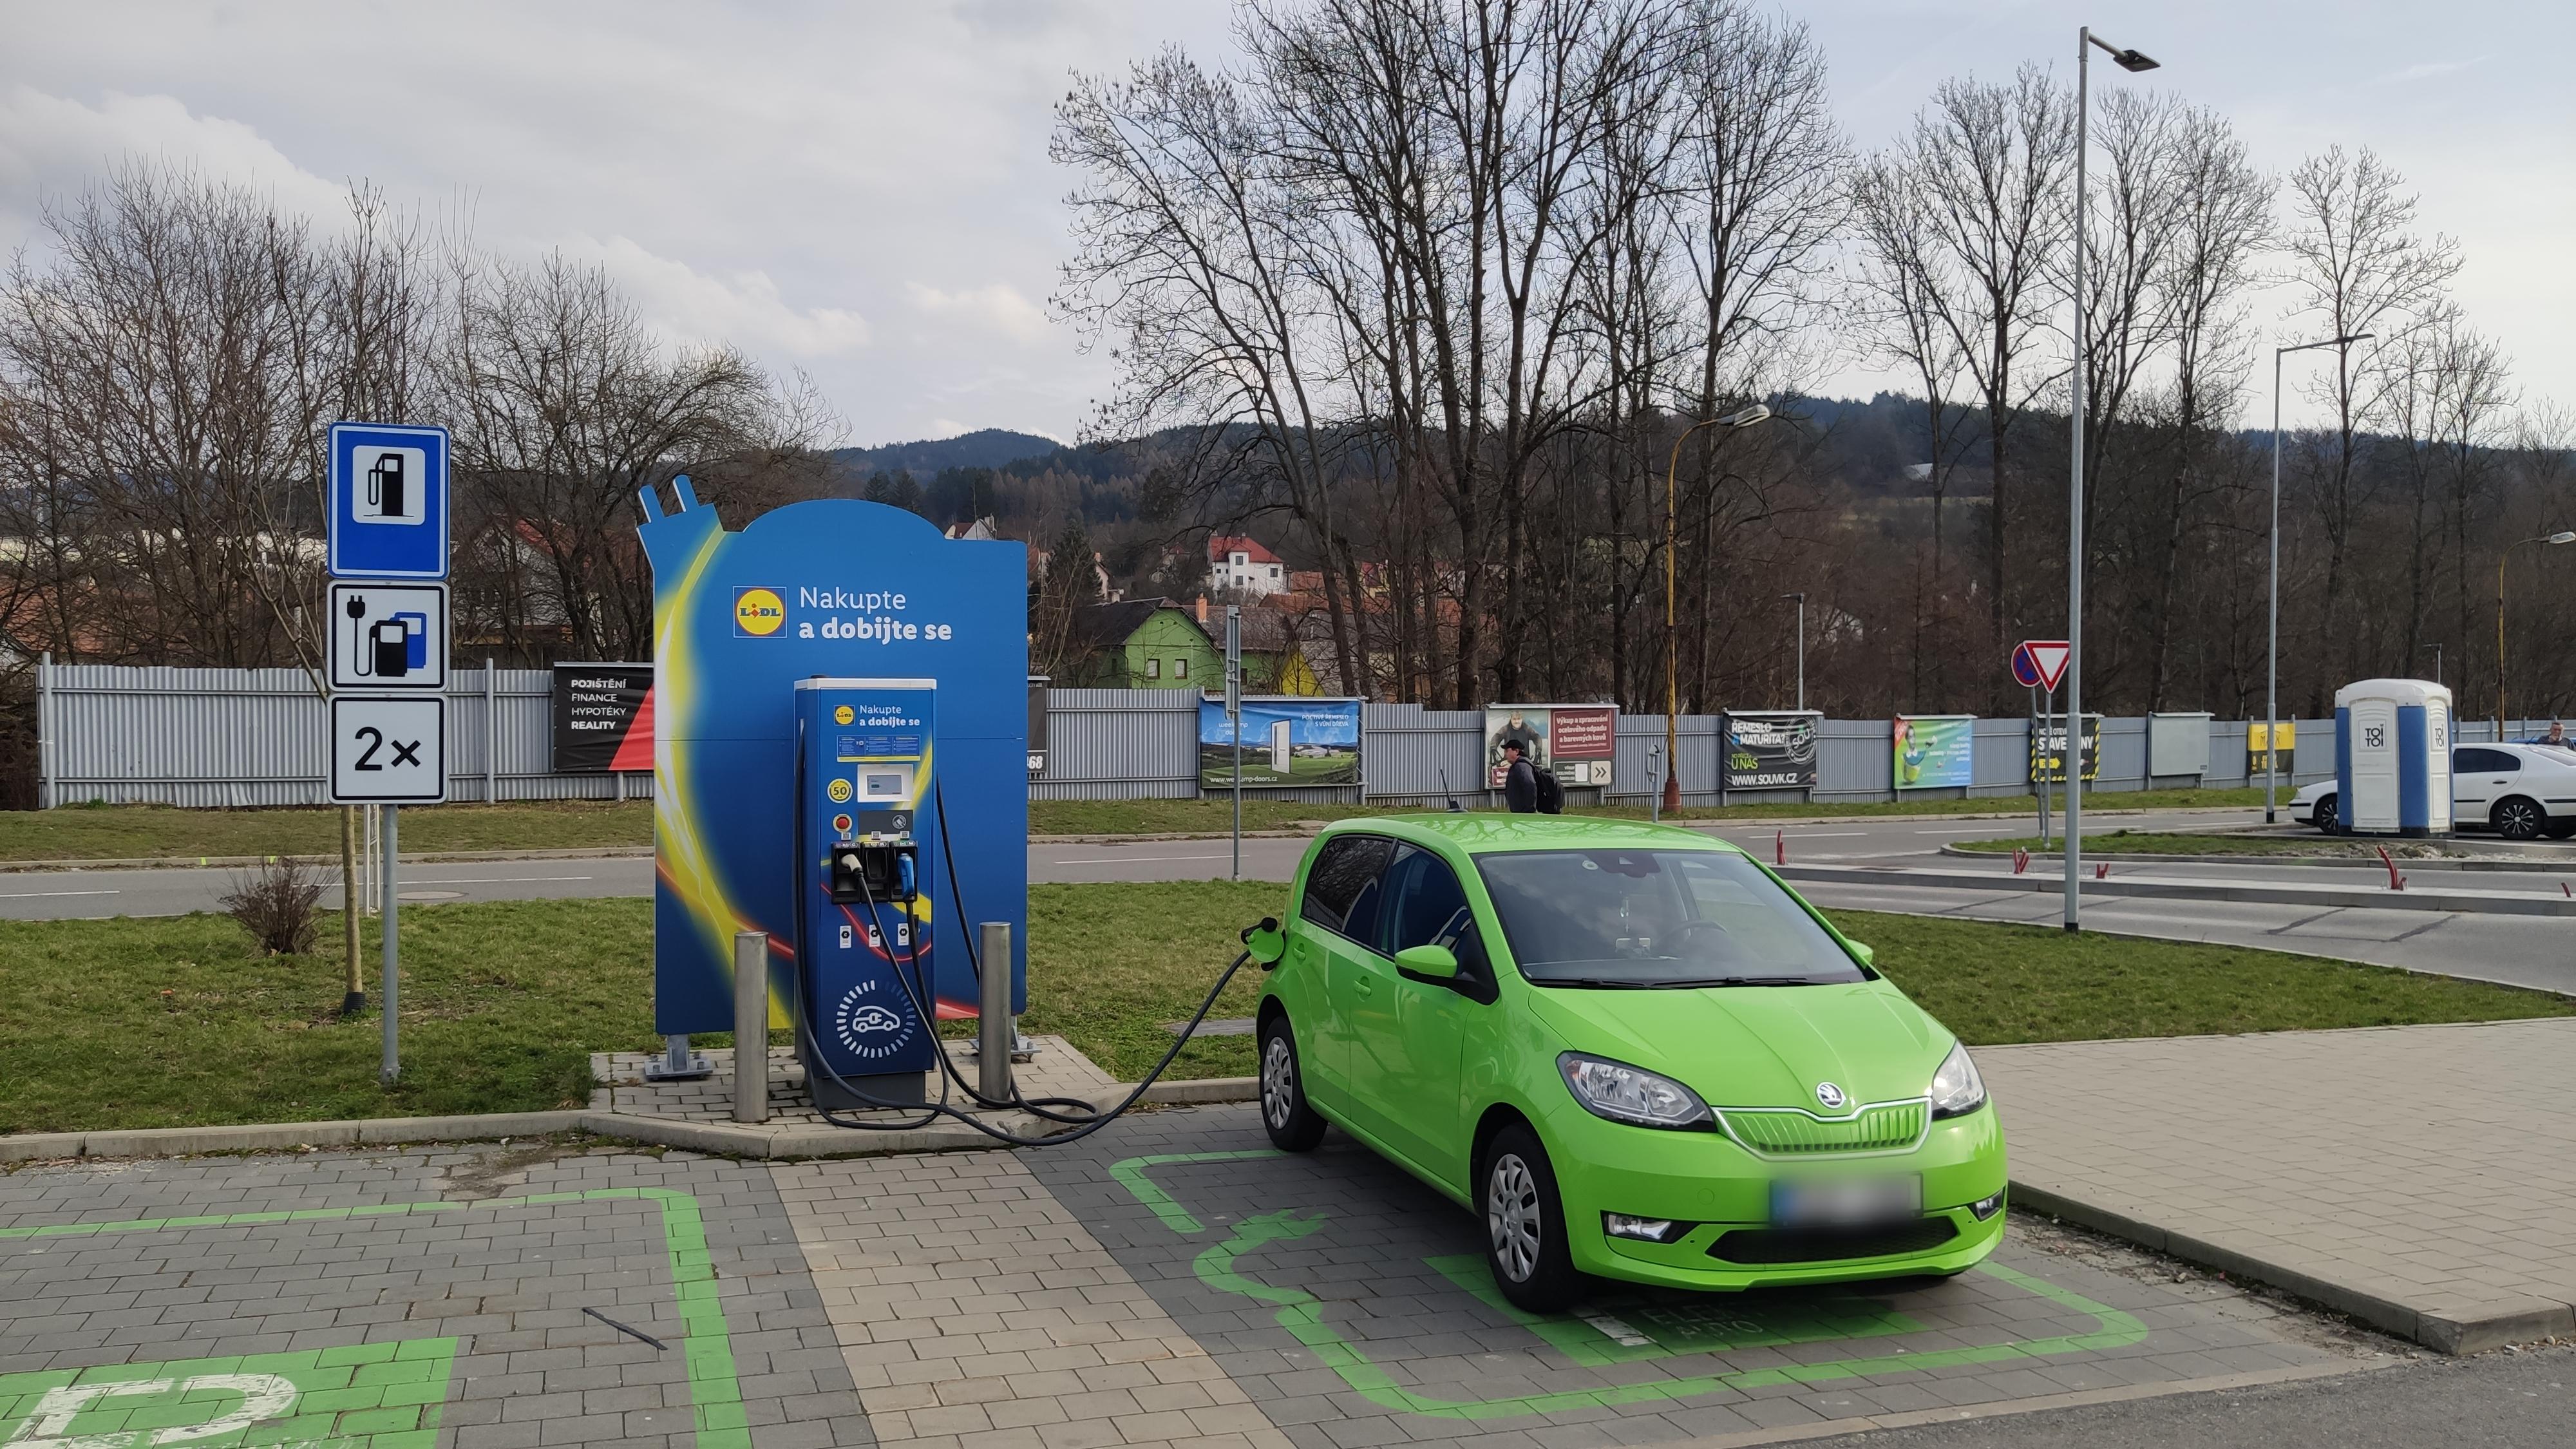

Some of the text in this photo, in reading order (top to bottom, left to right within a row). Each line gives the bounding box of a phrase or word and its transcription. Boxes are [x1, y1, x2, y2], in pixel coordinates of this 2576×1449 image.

[800, 586, 907, 614] Nakupte
[799, 616, 952, 645] a dobijte se
[571, 677, 627, 689] POJIŠTĚNÍ
[571, 693, 618, 702] FINANCE
[571, 706, 627, 716] HYPOTÉKY
[860, 705, 902, 715] Nakupte
[868, 716, 907, 728] dobijte
[909, 718, 920, 726] se
[1556, 716, 1574, 725] Výkup
[1578, 714, 1609, 724] zpracování
[571, 721, 616, 730] REALITY
[1558, 724, 1607, 734] ocelového odpadu
[1731, 719, 1772, 733] ŘEMESLO
[1563, 734, 1592, 743] barevných
[1739, 734, 1785, 745] MATURITA?
[1792, 728, 1811, 749] SOU
[2038, 735, 2094, 752] SAVENY
[2365, 737, 2384, 747] TOI
[1027, 755, 1043, 769] 68
[1731, 758, 1738, 770] U
[1731, 772, 1798, 786] WWW.SOUVK.CZ
[833, 786, 848, 796] 50
